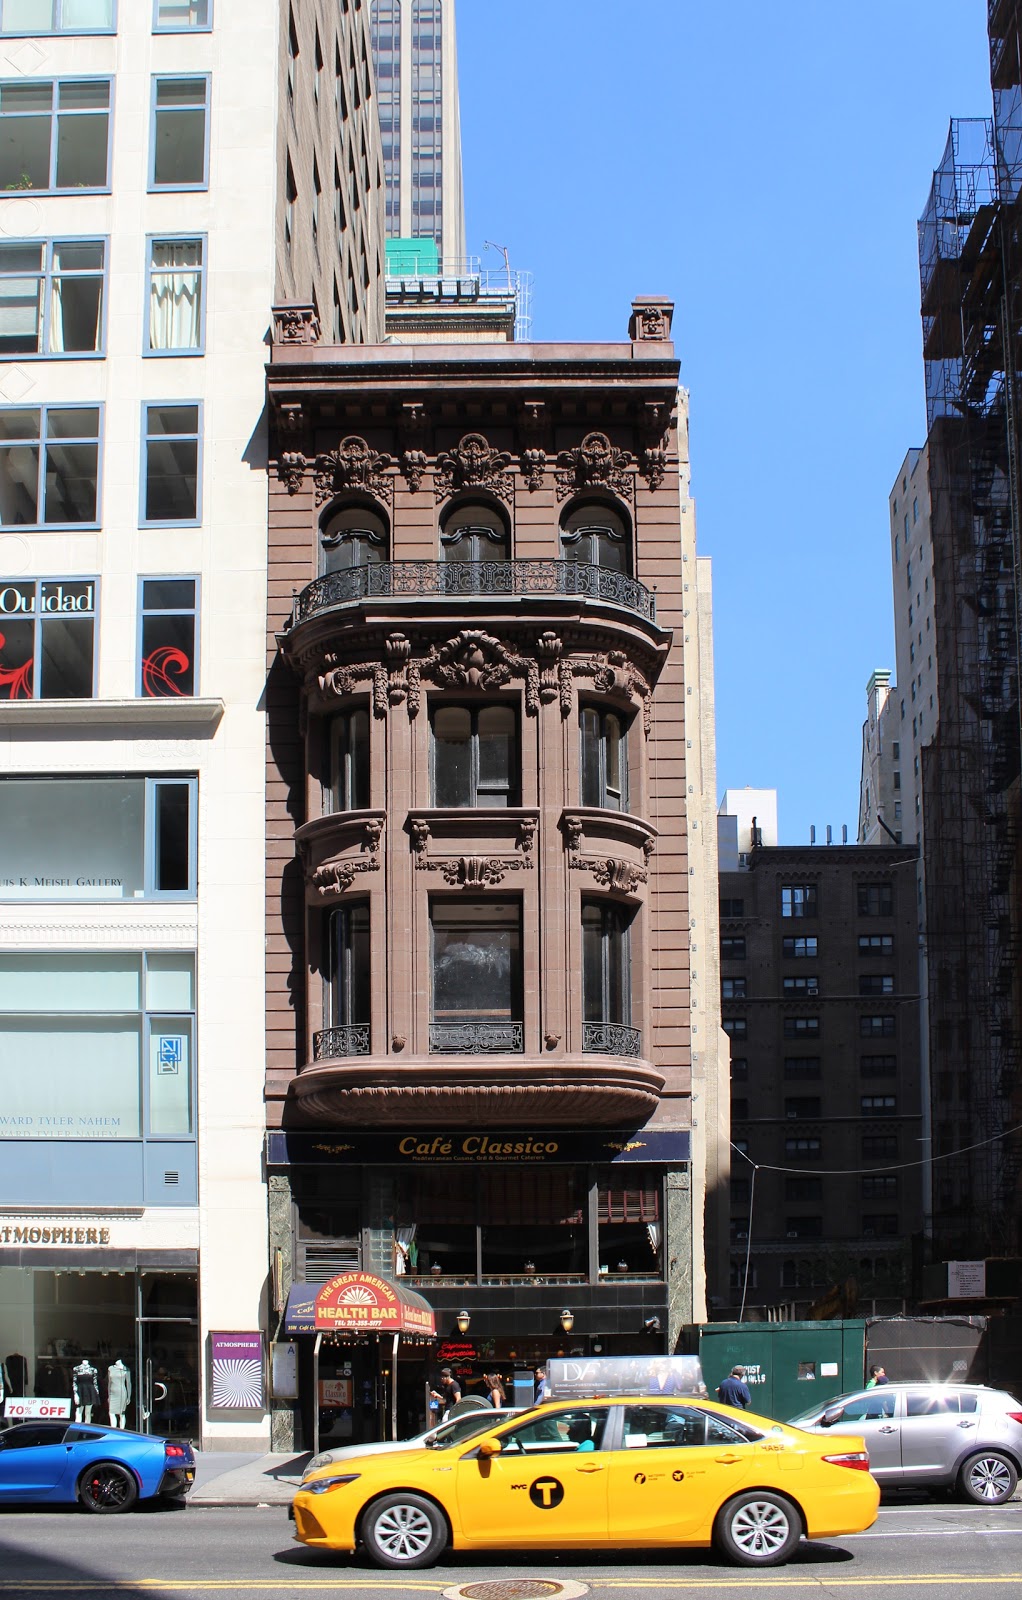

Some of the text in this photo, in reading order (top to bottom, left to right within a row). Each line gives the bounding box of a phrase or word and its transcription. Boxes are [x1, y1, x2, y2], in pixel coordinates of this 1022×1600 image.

[0, 586, 93, 613] Ouidad
[76, 877, 122, 886] GALLERY
[38, 1116, 74, 1125] TYLER
[79, 1117, 121, 1126] NAHEM
[399, 1136, 559, 1155] Café Classico
[0, 1226, 110, 1244] TMOSPHERE
[320, 1274, 396, 1302] THE GREAT AMERICAN
[318, 1307, 369, 1319] HEALTH
[371, 1307, 397, 1319] BAR
[287, 1346, 295, 1354] A
[9, 1406, 66, 1416] 70% OFF
